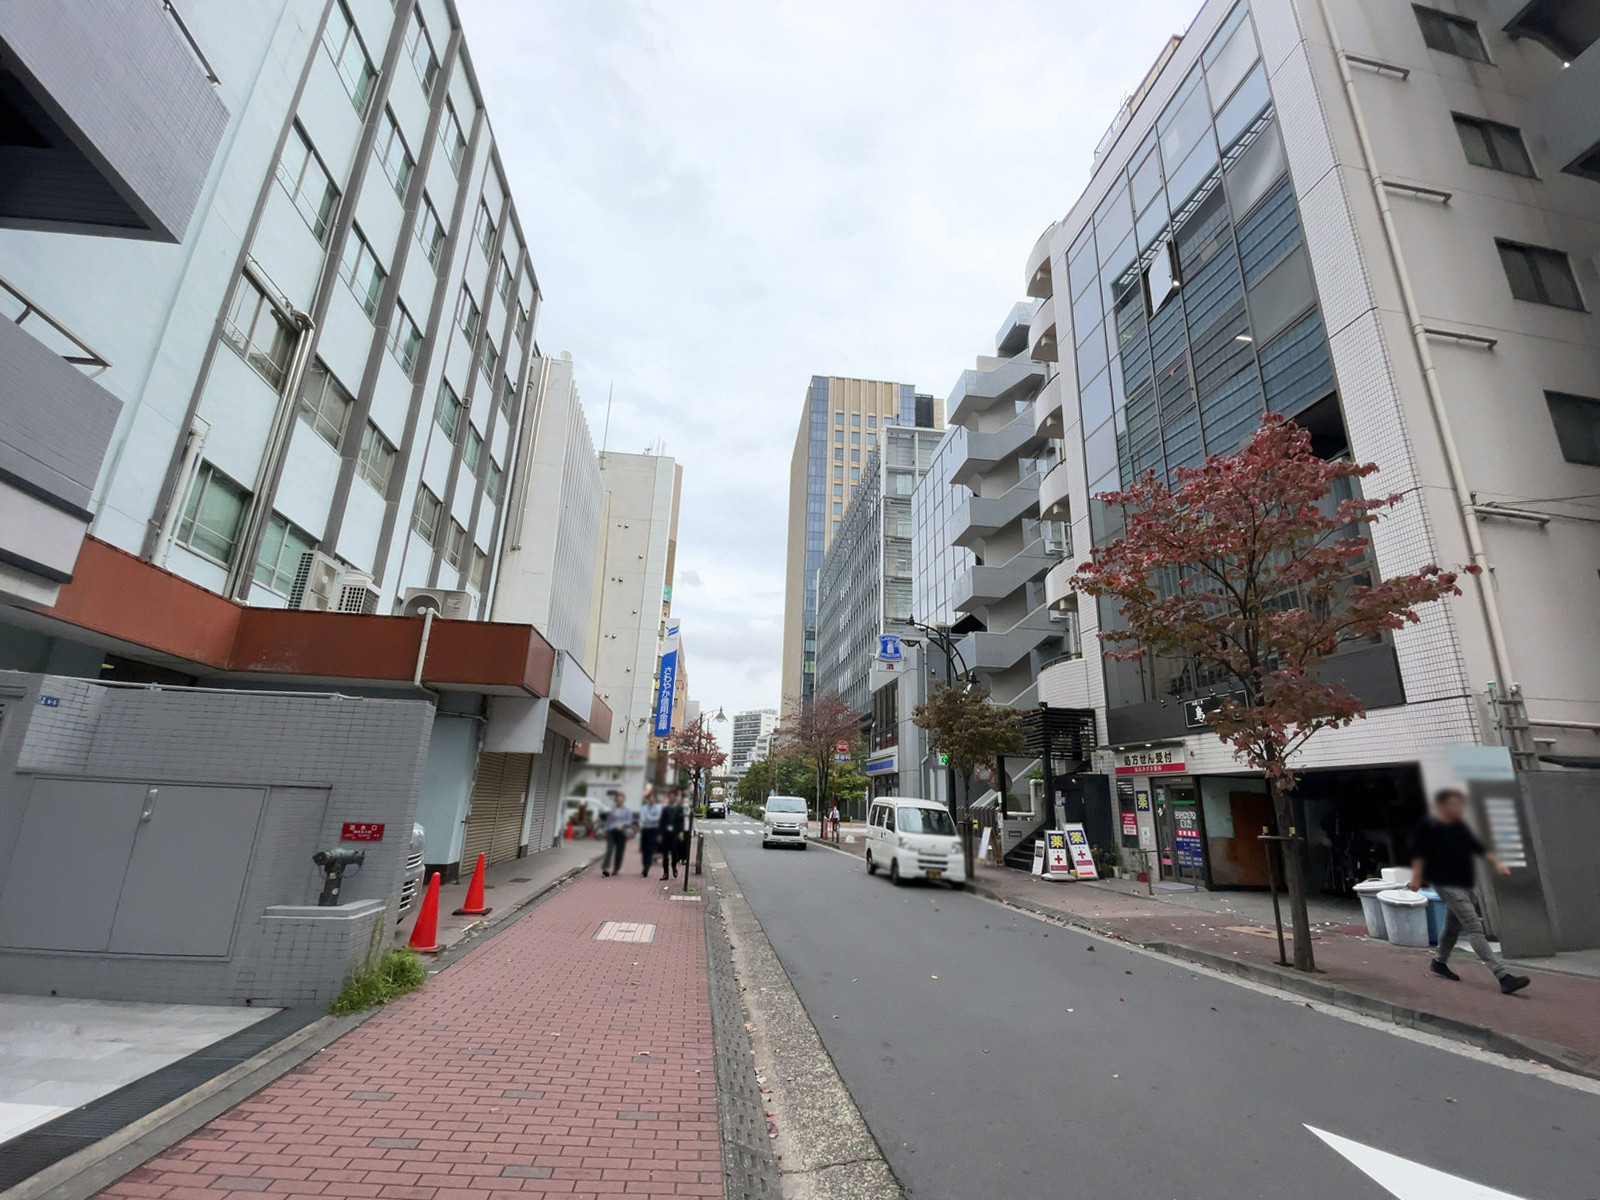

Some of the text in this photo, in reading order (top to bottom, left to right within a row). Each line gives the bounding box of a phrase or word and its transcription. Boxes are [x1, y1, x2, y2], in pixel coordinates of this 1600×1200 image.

[658, 666, 672, 730] さわやか信用金庫
[1123, 751, 1172, 766] 処方せん受付
[1137, 793, 1149, 809] 薬
[1050, 835, 1064, 848] 薬
[1070, 831, 1085, 844] 薬
